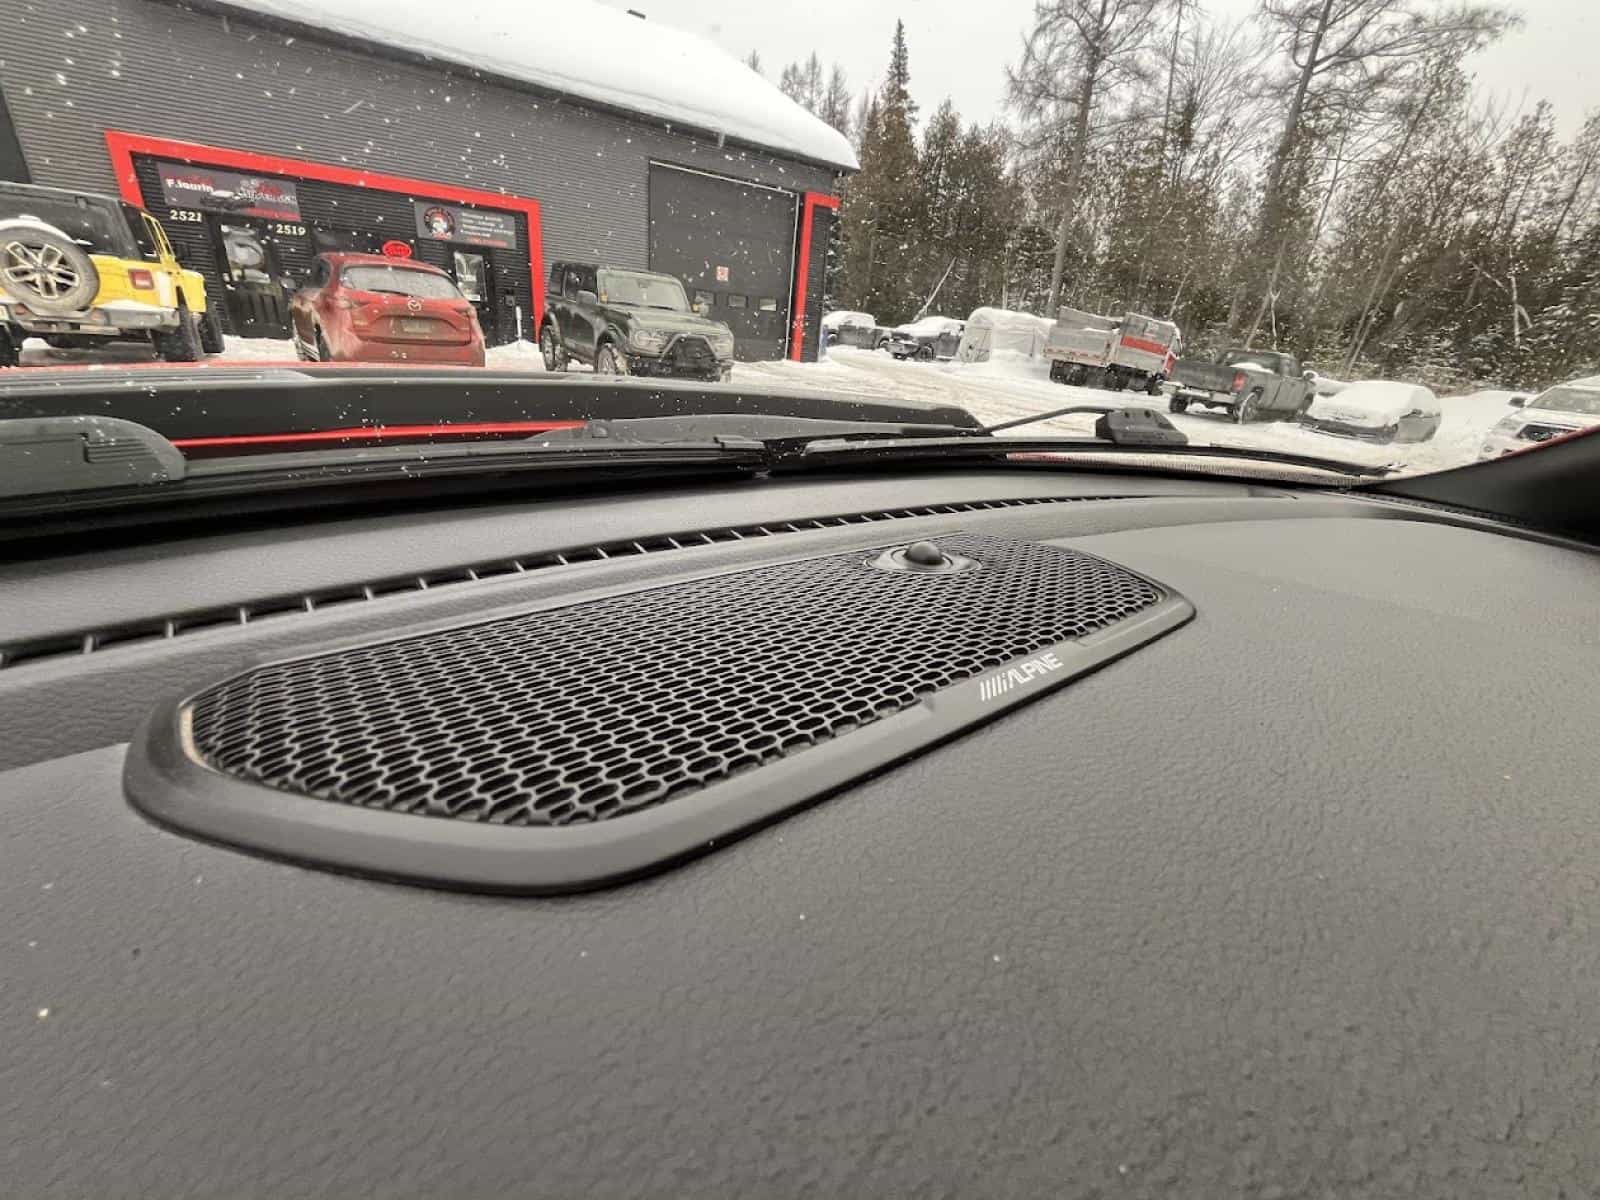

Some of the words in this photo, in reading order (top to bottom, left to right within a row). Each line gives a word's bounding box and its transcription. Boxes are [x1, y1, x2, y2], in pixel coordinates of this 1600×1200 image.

[169, 209, 202, 222] 2521
[276, 223, 306, 236] 2519
[1007, 652, 1064, 689] ALPINE
